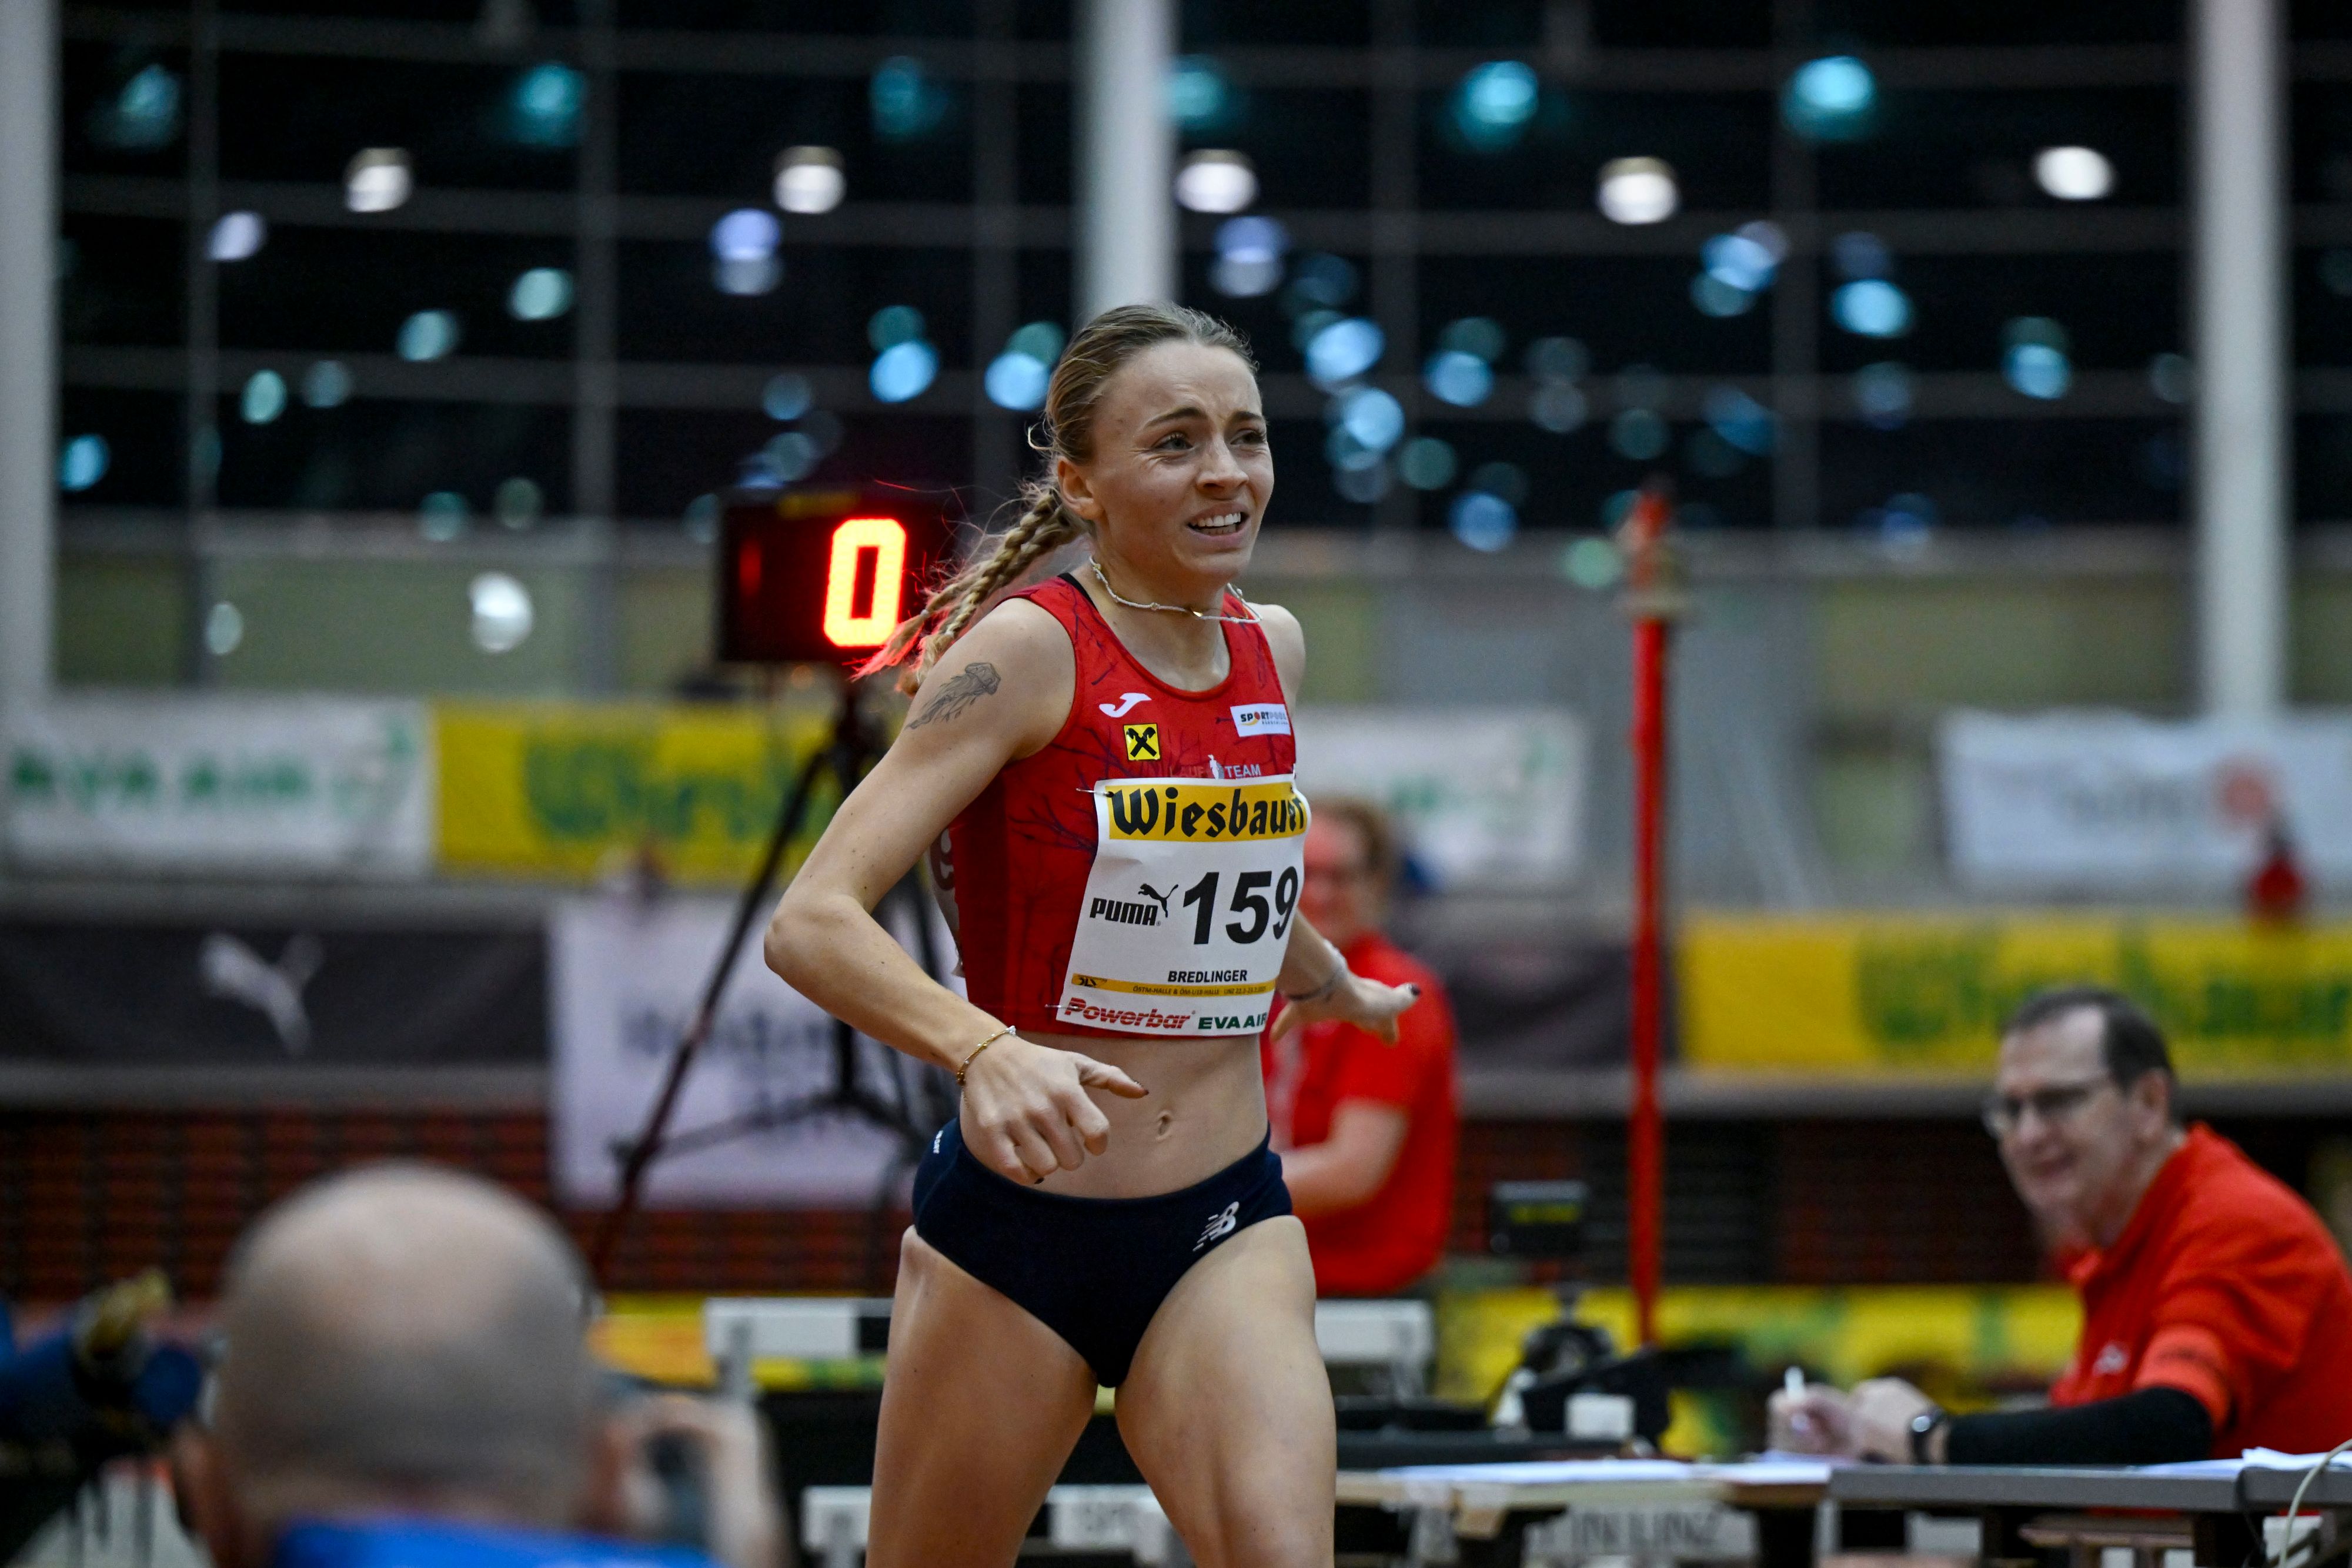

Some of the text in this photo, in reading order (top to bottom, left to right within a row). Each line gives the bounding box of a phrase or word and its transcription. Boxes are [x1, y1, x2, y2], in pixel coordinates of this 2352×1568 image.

[1225, 764, 1261, 778] TEAM
[1090, 897, 1158, 926] PUMA
[1183, 866, 1298, 945] 159
[1168, 969, 1248, 983] BREDLINGER
[1064, 997, 1191, 1029] Powerbar
